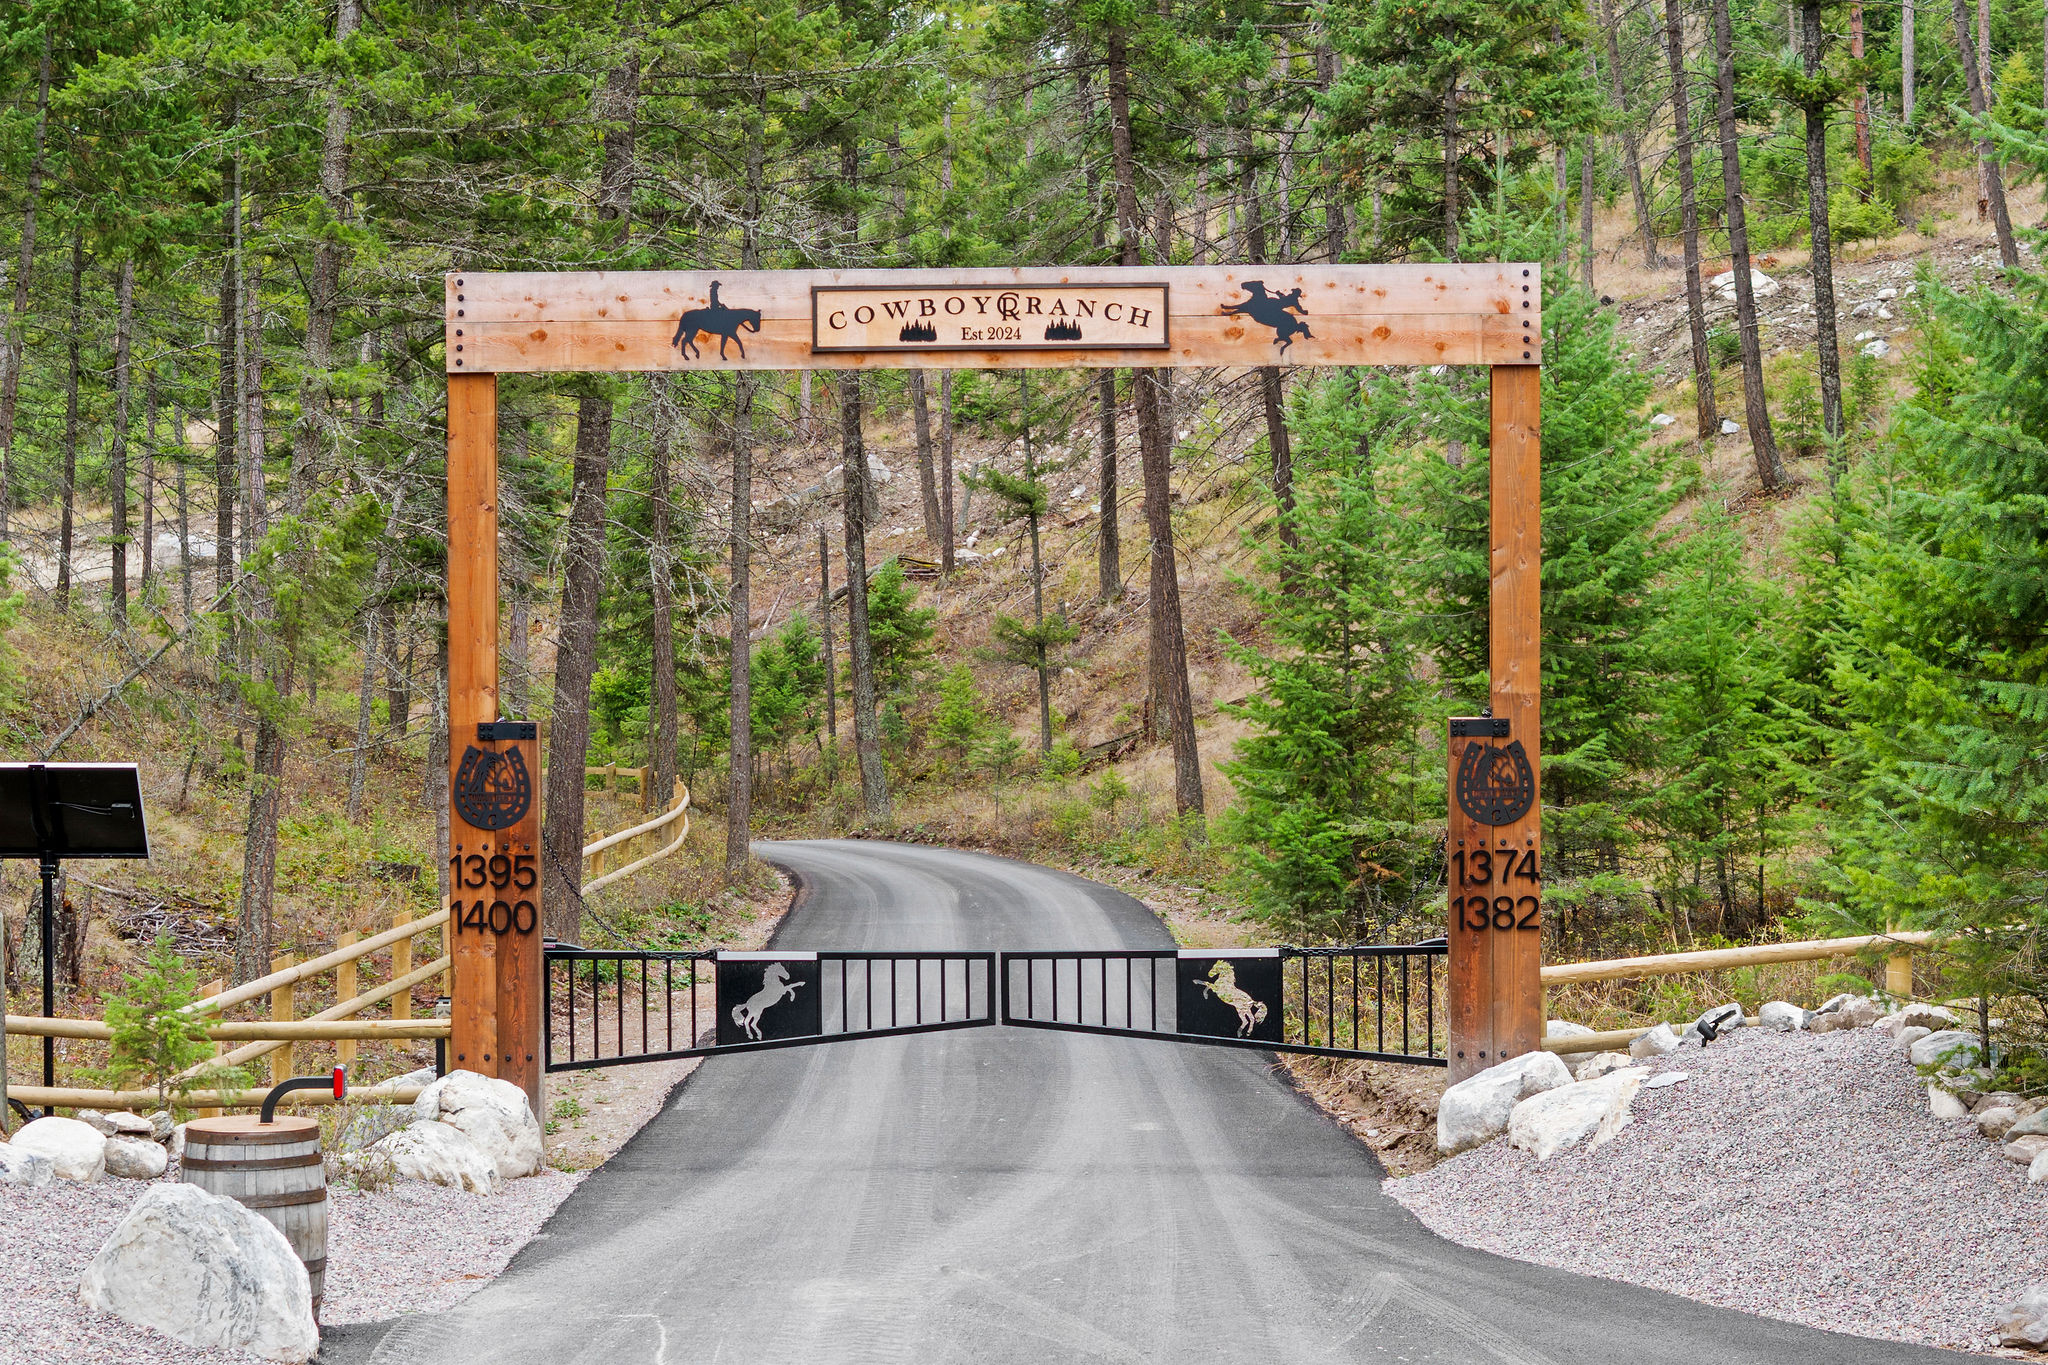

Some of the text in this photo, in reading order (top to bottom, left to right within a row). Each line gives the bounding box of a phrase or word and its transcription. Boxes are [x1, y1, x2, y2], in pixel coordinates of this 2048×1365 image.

[829, 295, 992, 331] COWBOY
[1025, 295, 1154, 328] RANCH
[961, 326, 1022, 341] Est 2024
[450, 854, 537, 889] 1395
[1451, 849, 1540, 885] 1374
[450, 900, 537, 935] 1400
[1451, 895, 1540, 931] 1382
